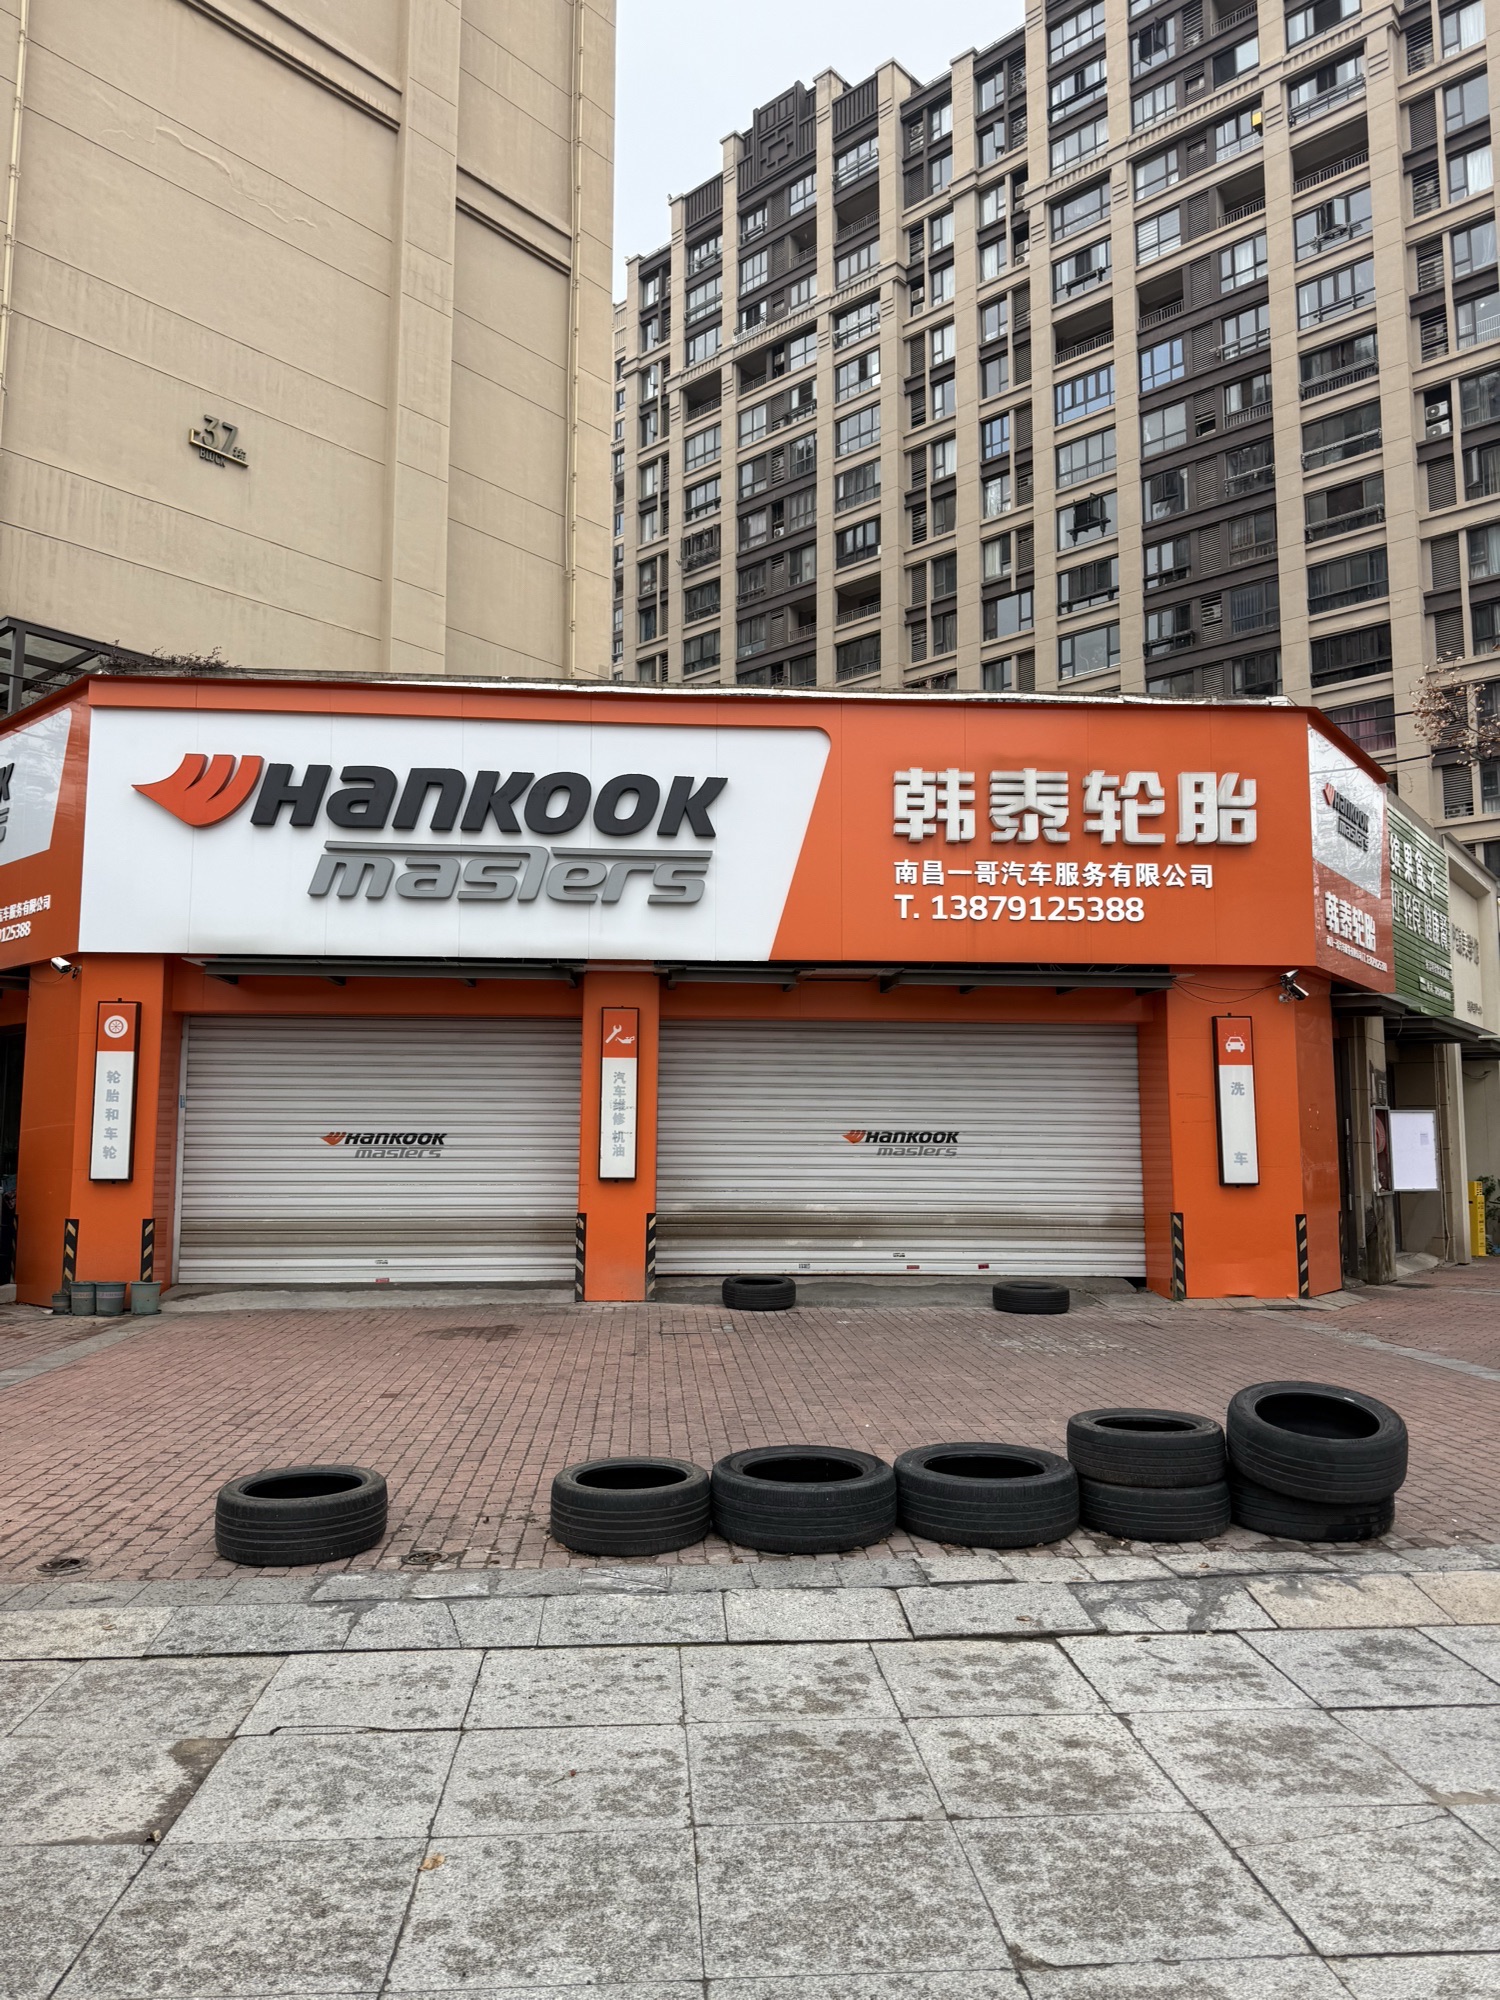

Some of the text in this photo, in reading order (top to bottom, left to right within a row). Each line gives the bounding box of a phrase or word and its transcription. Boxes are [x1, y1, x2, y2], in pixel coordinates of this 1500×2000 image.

[202, 414, 238, 454] 37
[893, 767, 1257, 845] 韩泰轮胎
[308, 840, 713, 904] masters
[893, 859, 1213, 889] 南昌一哥汽车服务有限公司
[893, 894, 1145, 922] T. 13879125388
[1325, 891, 1376, 952] 韩泰轮胎
[0, 920, 31, 943] 125388
[103, 1070, 121, 1159] 轮胎和车轮
[355, 1146, 445, 1158] masters
[876, 1145, 958, 1157] masters
